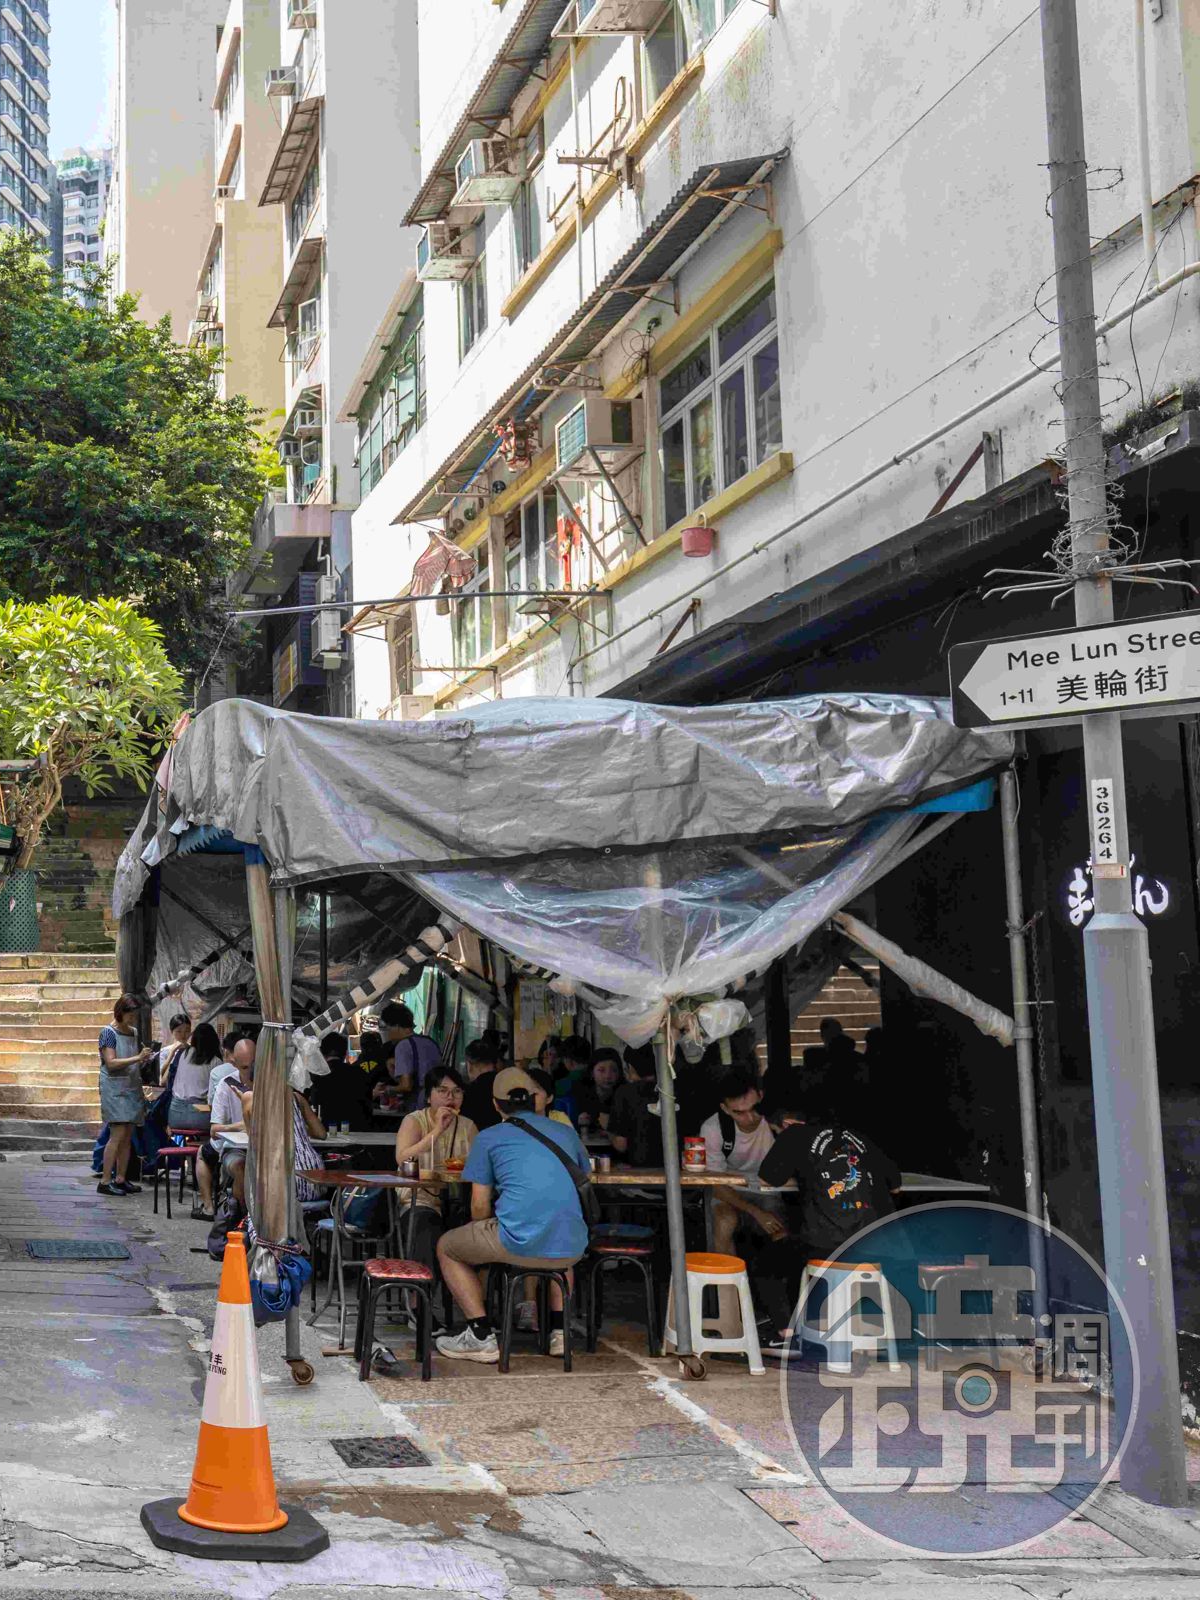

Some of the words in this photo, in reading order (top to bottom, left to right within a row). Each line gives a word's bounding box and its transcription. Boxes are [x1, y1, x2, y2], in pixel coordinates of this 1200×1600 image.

[1007, 650, 1060, 670] Mee
[1071, 643, 1118, 662] Lun
[1127, 631, 1200, 653] Stree
[1056, 665, 1169, 704] 美輪街
[1096, 787, 1113, 859] 36264
